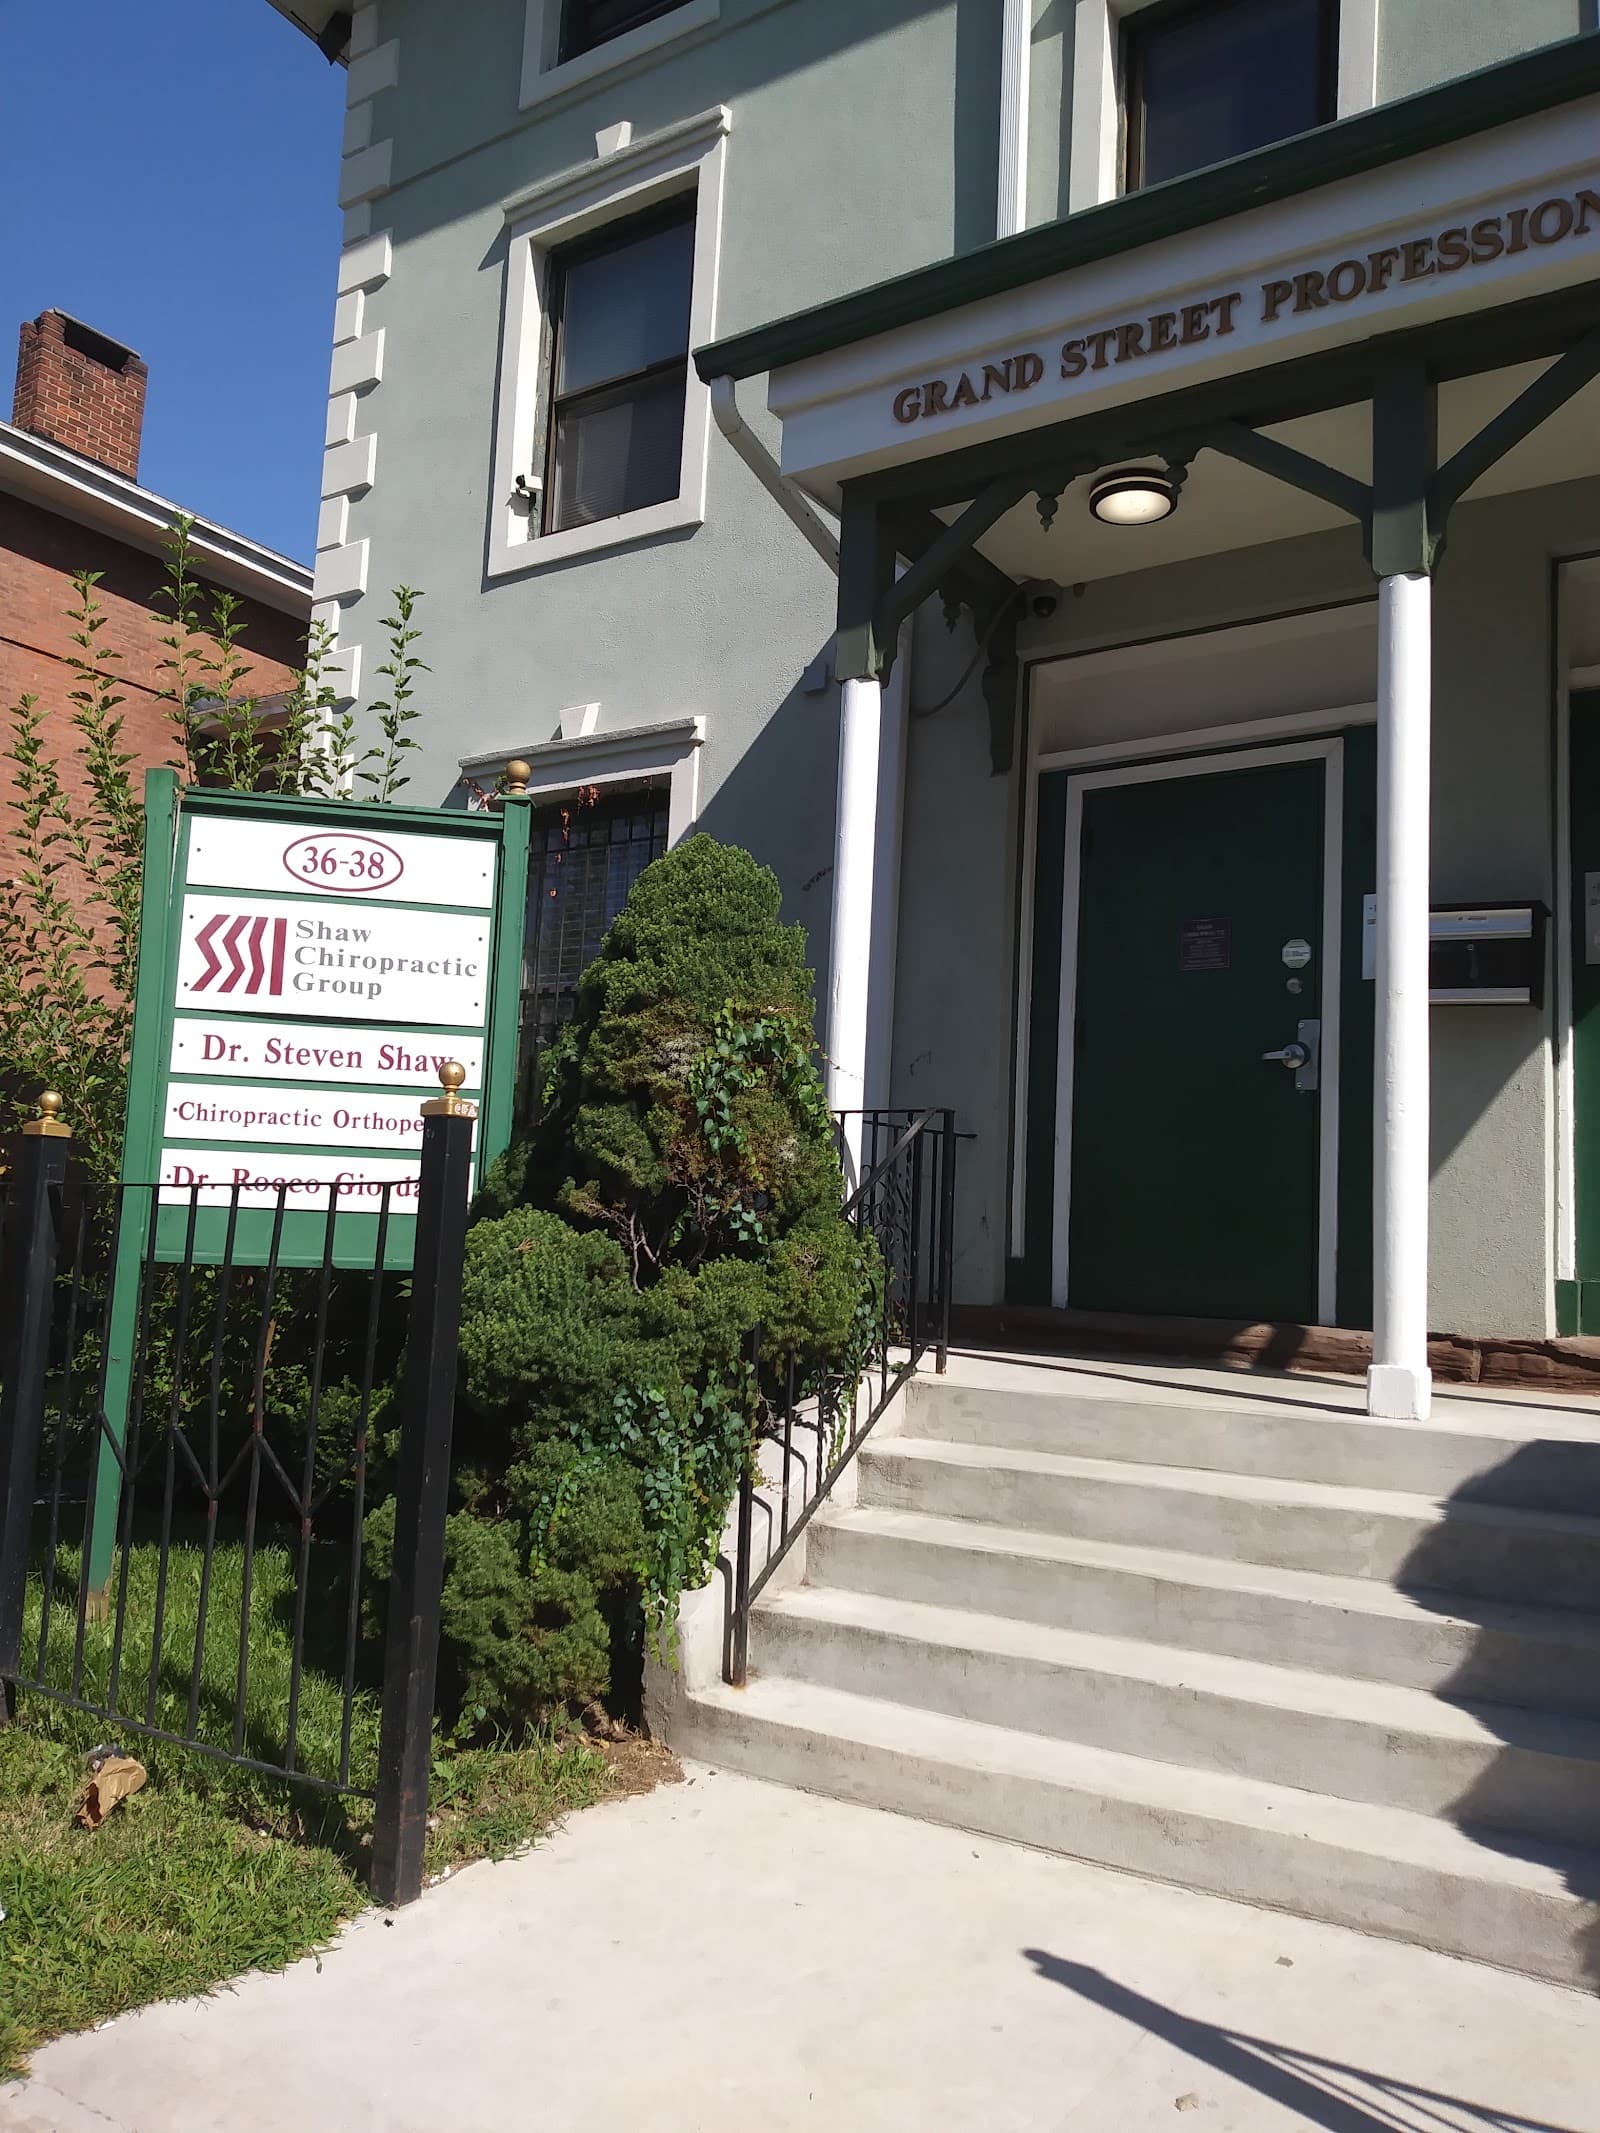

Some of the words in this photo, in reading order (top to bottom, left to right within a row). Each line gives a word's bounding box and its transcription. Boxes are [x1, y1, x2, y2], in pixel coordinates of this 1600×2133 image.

[892, 352, 1044, 424] GRAND
[1060, 291, 1242, 379] STREET
[302, 846, 385, 879] 36-38
[295, 919, 371, 943] Shaw
[294, 946, 478, 977] Chiropractic
[292, 972, 382, 1000] Group
[201, 1034, 249, 1063] Dr.
[264, 1038, 363, 1069] Steven
[178, 1101, 322, 1128] Chiropractic
[170, 1165, 216, 1191] Dr.
[231, 1168, 320, 1194] Rocco
